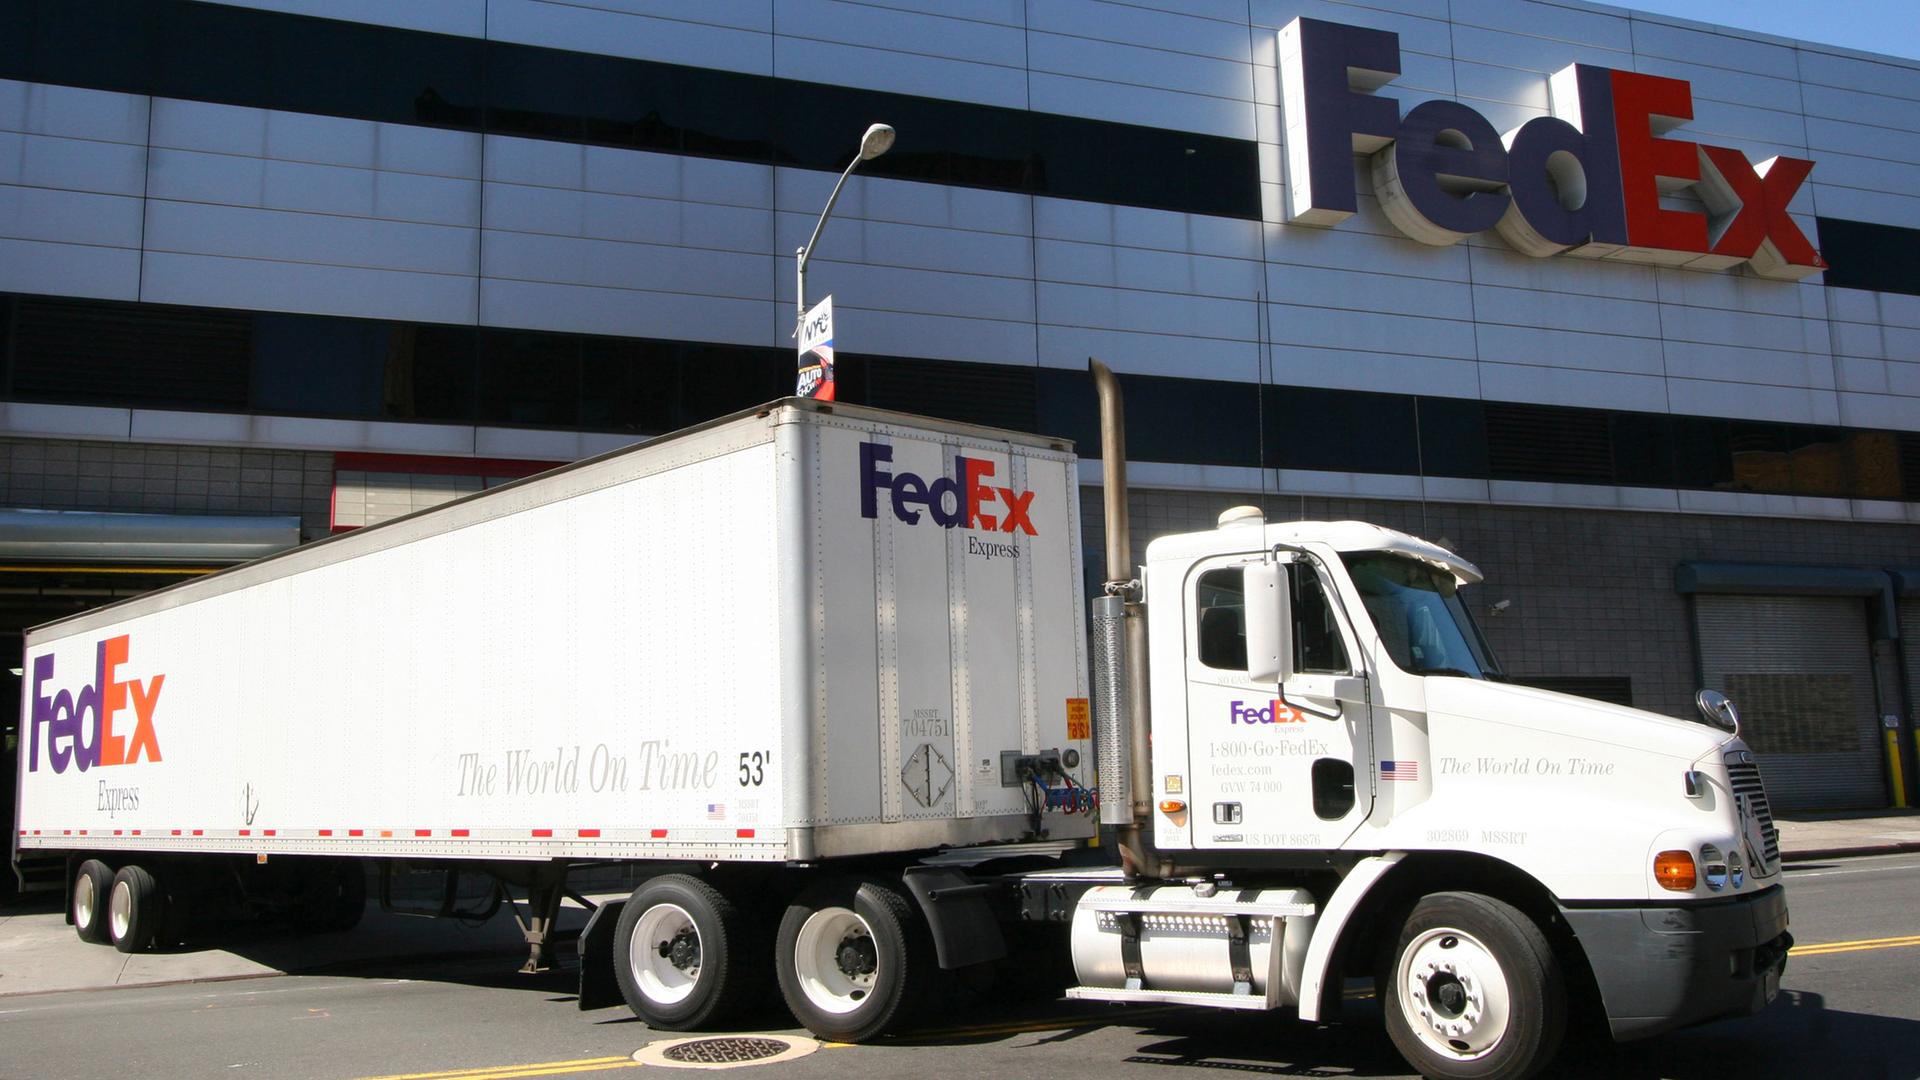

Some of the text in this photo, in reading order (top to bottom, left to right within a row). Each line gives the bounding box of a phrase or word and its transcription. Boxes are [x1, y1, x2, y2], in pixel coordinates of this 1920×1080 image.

[1294, 17, 1828, 272] FedEx
[797, 368, 822, 391] AUTO
[859, 441, 1039, 537] FedEx
[968, 536, 1020, 560] Express
[29, 633, 165, 775] FedEx
[1230, 699, 1307, 724] FedEx
[903, 718, 949, 737] 704751
[1274, 725, 1304, 735] Express
[456, 738, 718, 797] The World On Time
[738, 750, 770, 787] 53'
[1211, 764, 1272, 777] fedex.com
[1439, 757, 1615, 775] The World On Time
[97, 780, 140, 818] Express
[1220, 782, 1248, 793] GVW
[1245, 835, 1261, 845] US
[1263, 835, 1288, 845] DOT
[1426, 829, 1528, 845] 302869 MSSRT
